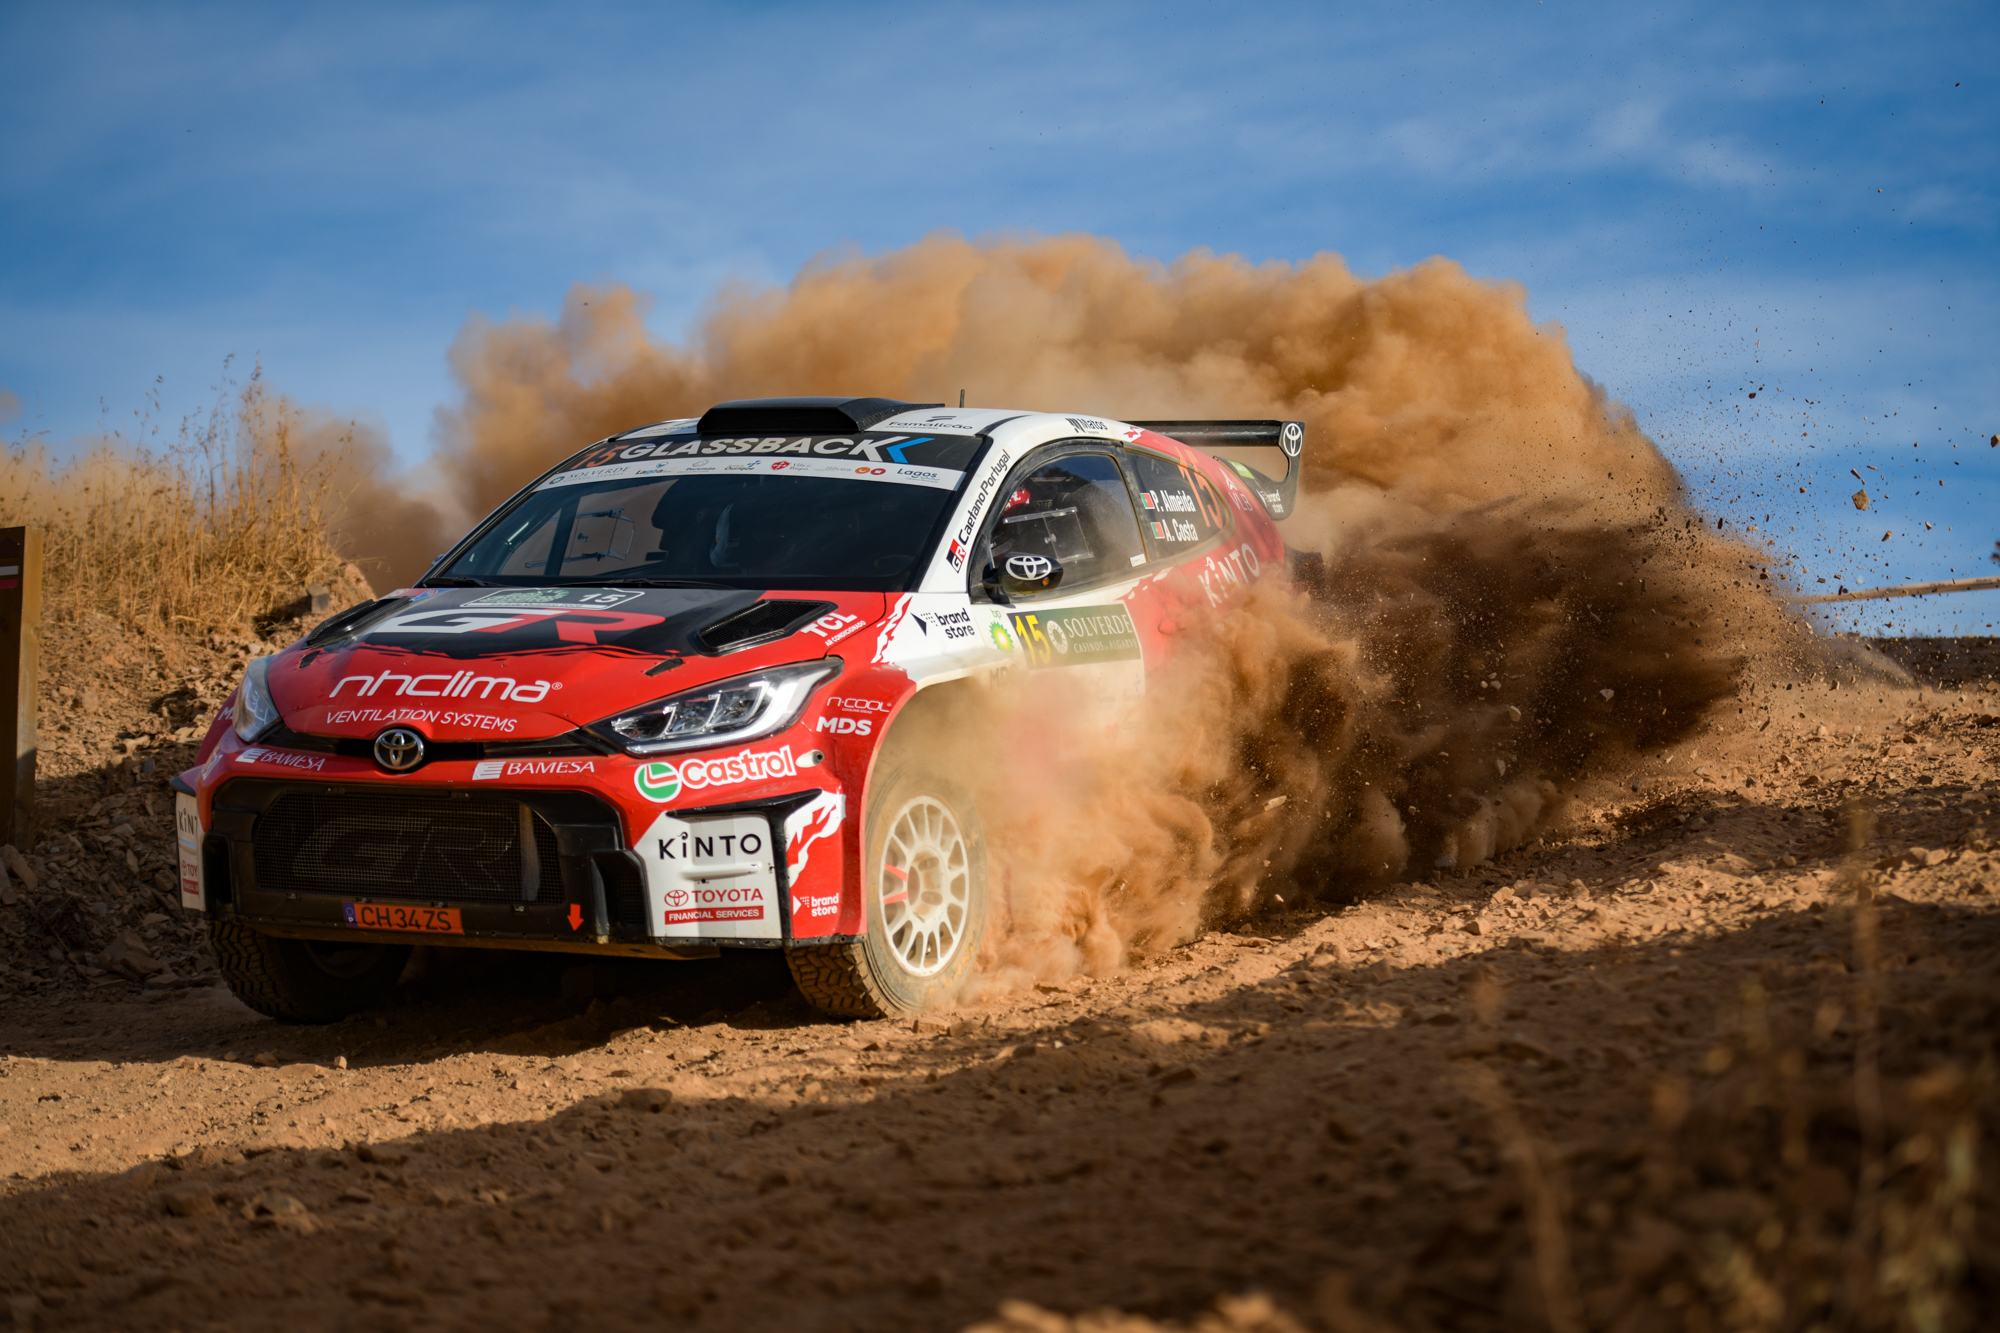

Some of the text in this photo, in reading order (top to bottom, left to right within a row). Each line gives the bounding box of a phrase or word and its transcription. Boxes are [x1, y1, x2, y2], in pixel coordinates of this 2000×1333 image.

[570, 445, 629, 470] 15
[619, 436, 909, 462] GLASSBACK
[897, 468, 938, 479] Lagos
[1174, 446, 1223, 529] 15
[1160, 490, 1196, 512] Almeida
[1228, 492, 1253, 512] VLB
[1172, 518, 1199, 542] Costa
[579, 593, 626, 603] 15
[934, 607, 971, 626] brand
[990, 608, 1002, 618] bp
[800, 612, 857, 637] TCL
[944, 625, 975, 639] store
[1064, 614, 1133, 638] SOLVERDE
[1015, 614, 1051, 665] 15
[1074, 641, 1104, 653] CASINOS
[1109, 638, 1138, 651] ALGARVE
[326, 709, 517, 733] VENTILATION SYSTEMS
[816, 716, 872, 736] MDS
[260, 751, 326, 771] BAMESA
[507, 761, 595, 775] BAMESA
[681, 746, 796, 788] Castrol
[691, 888, 763, 904] TOYOTA
[811, 892, 839, 906] brand
[668, 908, 760, 922] FINANCIAL SERVICES
[811, 905, 838, 917] store
